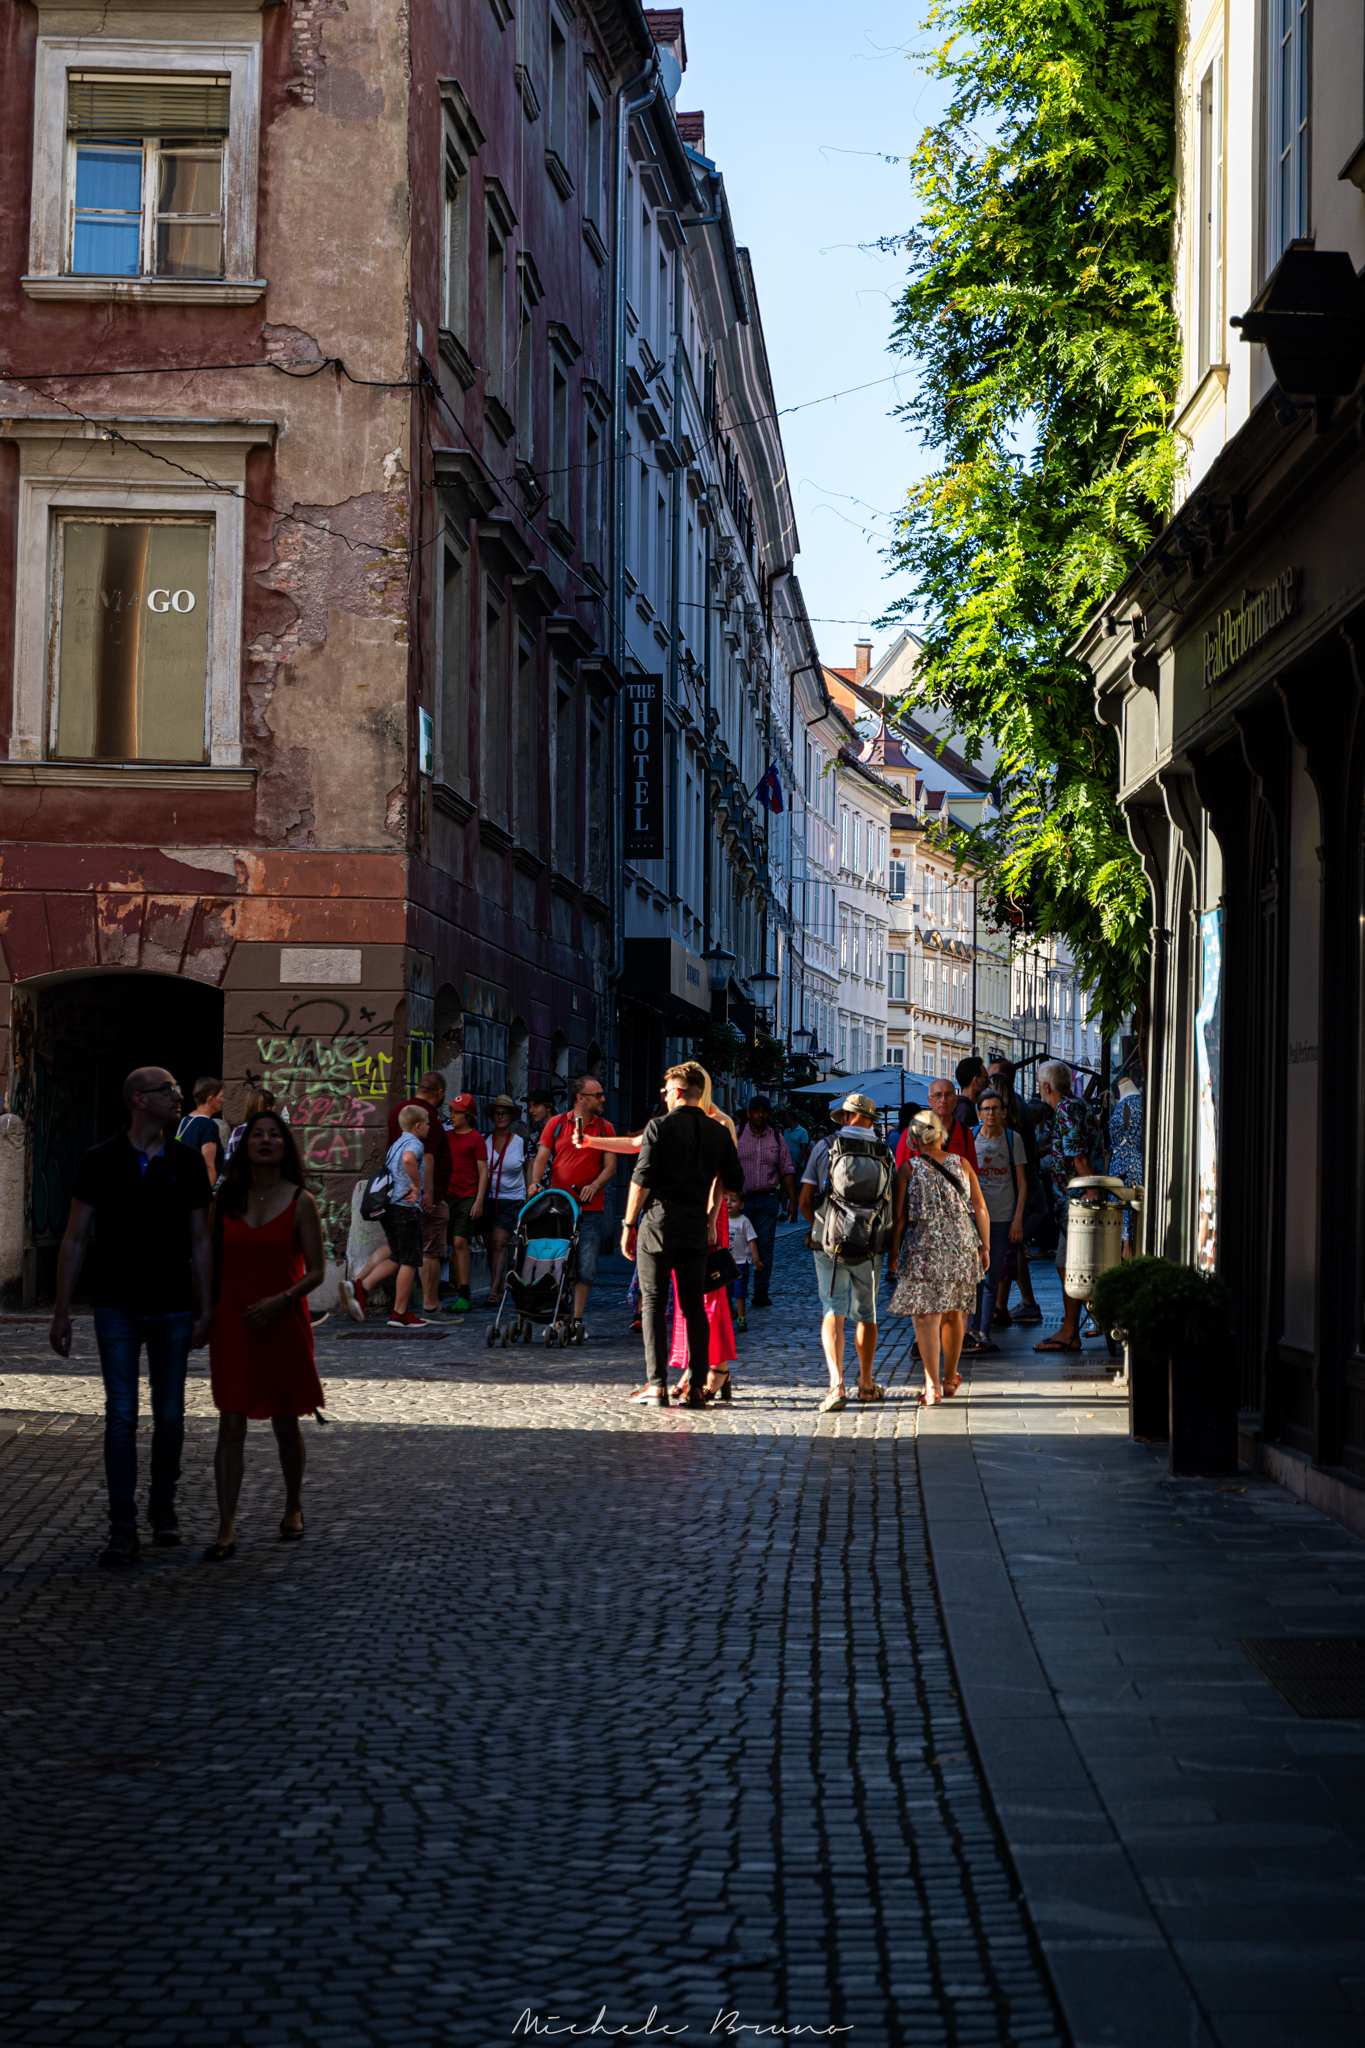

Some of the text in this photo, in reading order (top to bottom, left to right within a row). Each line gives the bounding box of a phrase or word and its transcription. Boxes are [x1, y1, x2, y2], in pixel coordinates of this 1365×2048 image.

[147, 588, 196, 613] GO
[1203, 566, 1293, 690] PeakPerformance
[626, 684, 656, 699] THE
[632, 701, 650, 831] HOTEL
